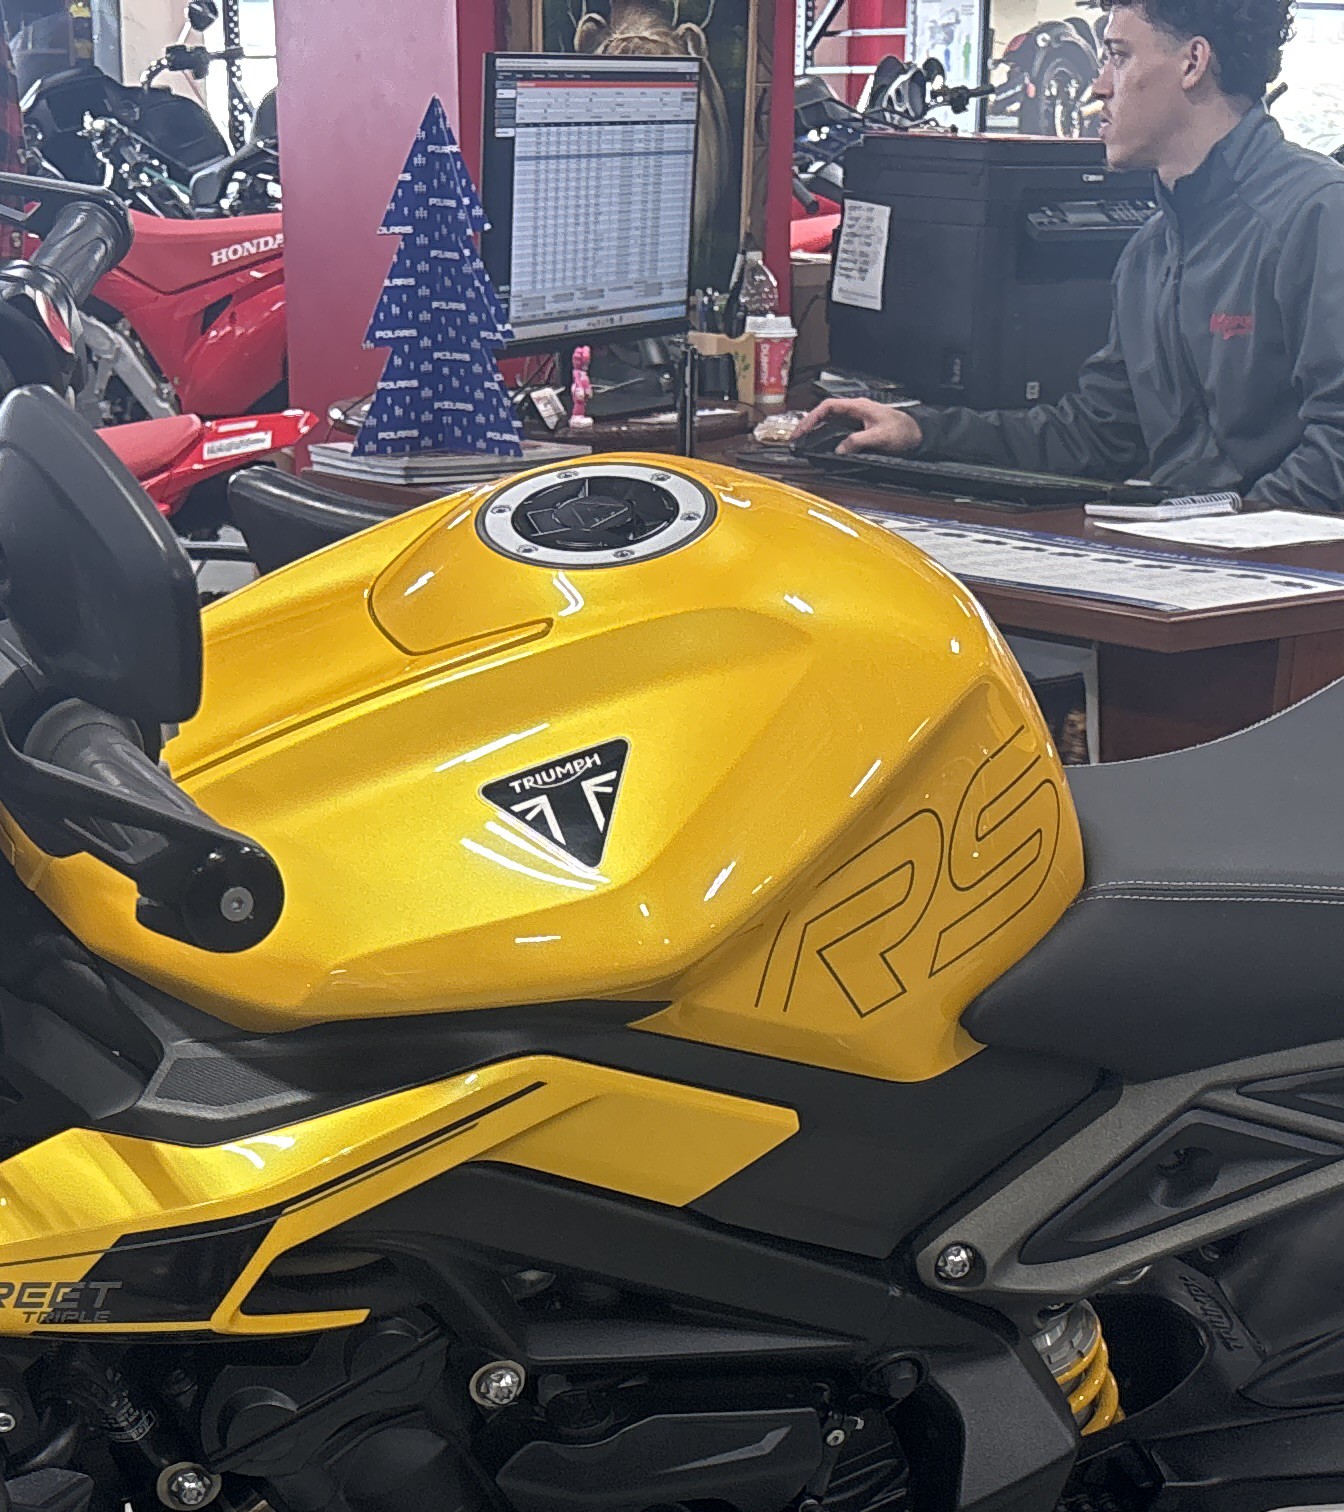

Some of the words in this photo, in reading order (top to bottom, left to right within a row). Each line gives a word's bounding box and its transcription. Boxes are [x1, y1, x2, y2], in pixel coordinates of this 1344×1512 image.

[376, 225, 414, 235] OLARIS
[432, 301, 467, 311] POLARIS
[375, 329, 418, 339] POLARIS
[433, 352, 471, 362] POLARIS
[377, 380, 419, 390] POLARIS
[434, 401, 474, 412] POLARIS
[378, 430, 419, 440] POLARIS
[508, 752, 602, 794] TRIUMPH
[753, 725, 1061, 1018] RS
[22, 1310, 111, 1324] TRIPLE
